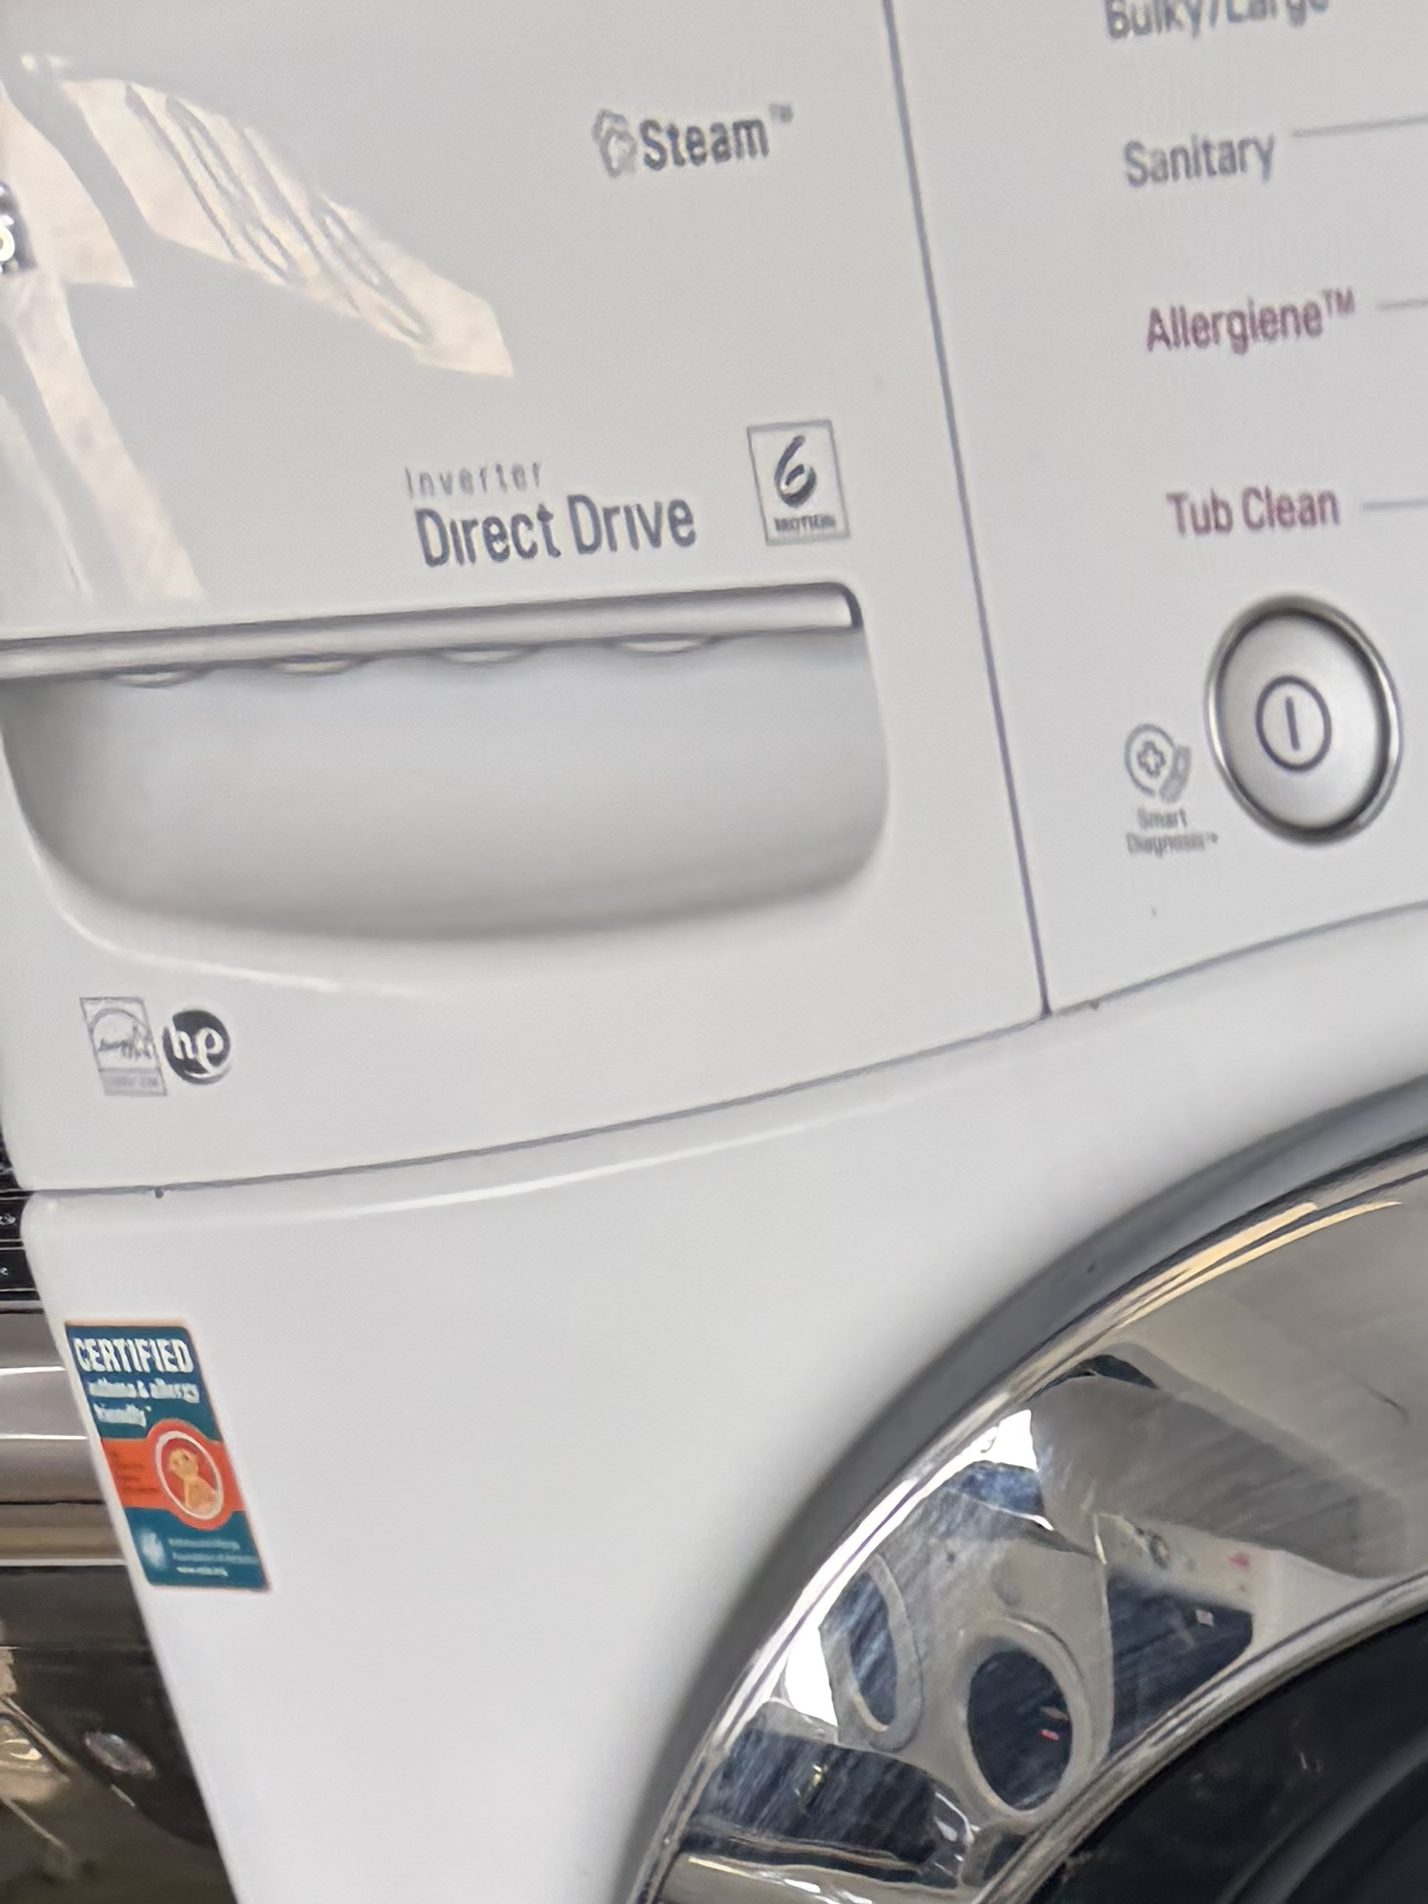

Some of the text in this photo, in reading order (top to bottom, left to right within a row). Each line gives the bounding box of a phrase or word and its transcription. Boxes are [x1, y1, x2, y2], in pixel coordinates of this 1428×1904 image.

[1122, 134, 1275, 188] Sanitary
[404, 462, 542, 498] Inverter
[414, 495, 697, 568] Direct Drive
[1167, 486, 1341, 537] Tub Clean
[73, 1337, 194, 1373] CERTIFIED
